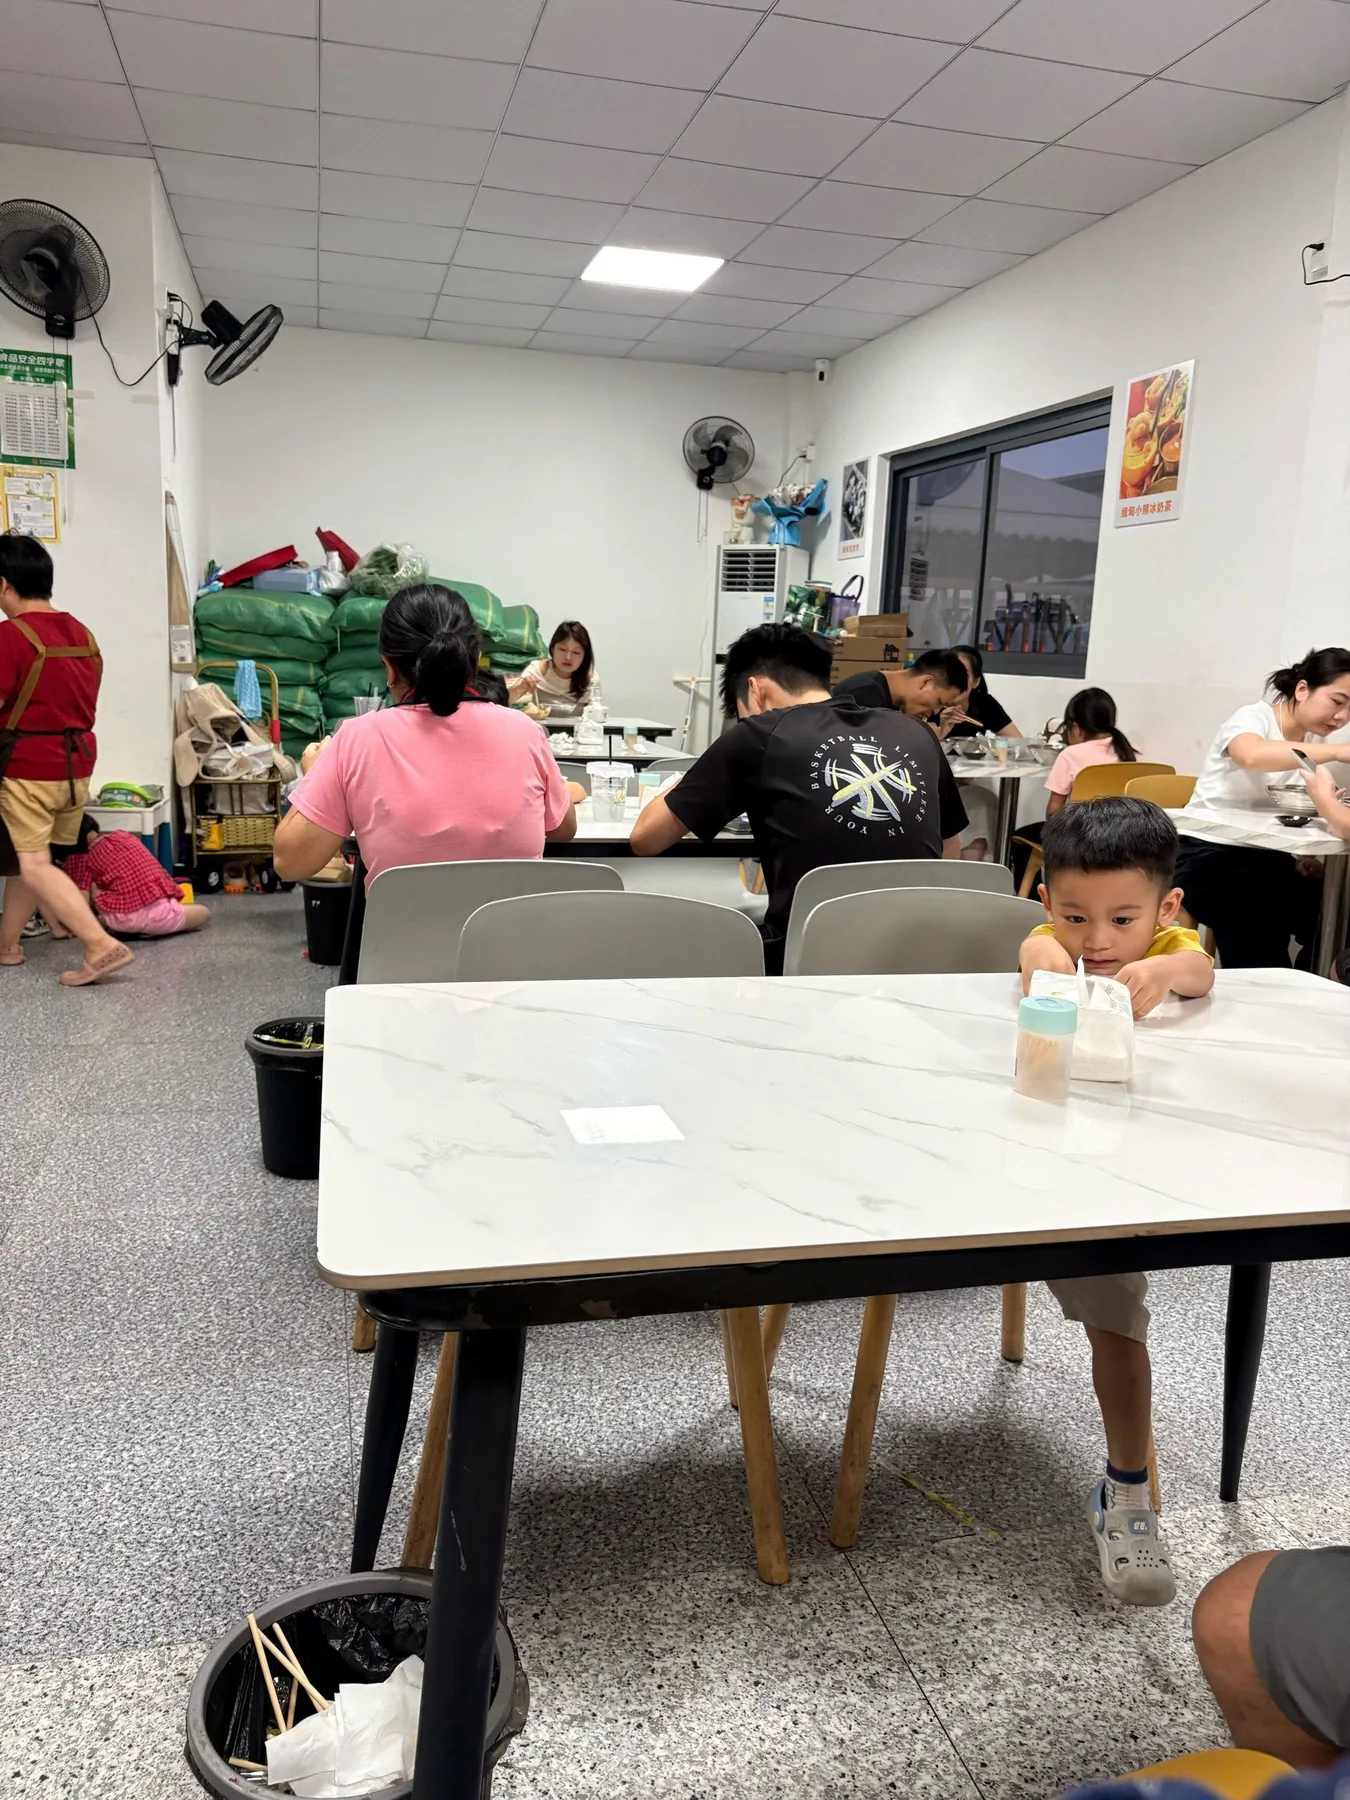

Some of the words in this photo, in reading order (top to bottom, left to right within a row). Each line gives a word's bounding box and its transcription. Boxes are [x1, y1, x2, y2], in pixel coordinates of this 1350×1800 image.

[810, 735, 877, 790] BASKETBALL
[825, 805, 868, 835] YOUR
[888, 826, 905, 837] IN
